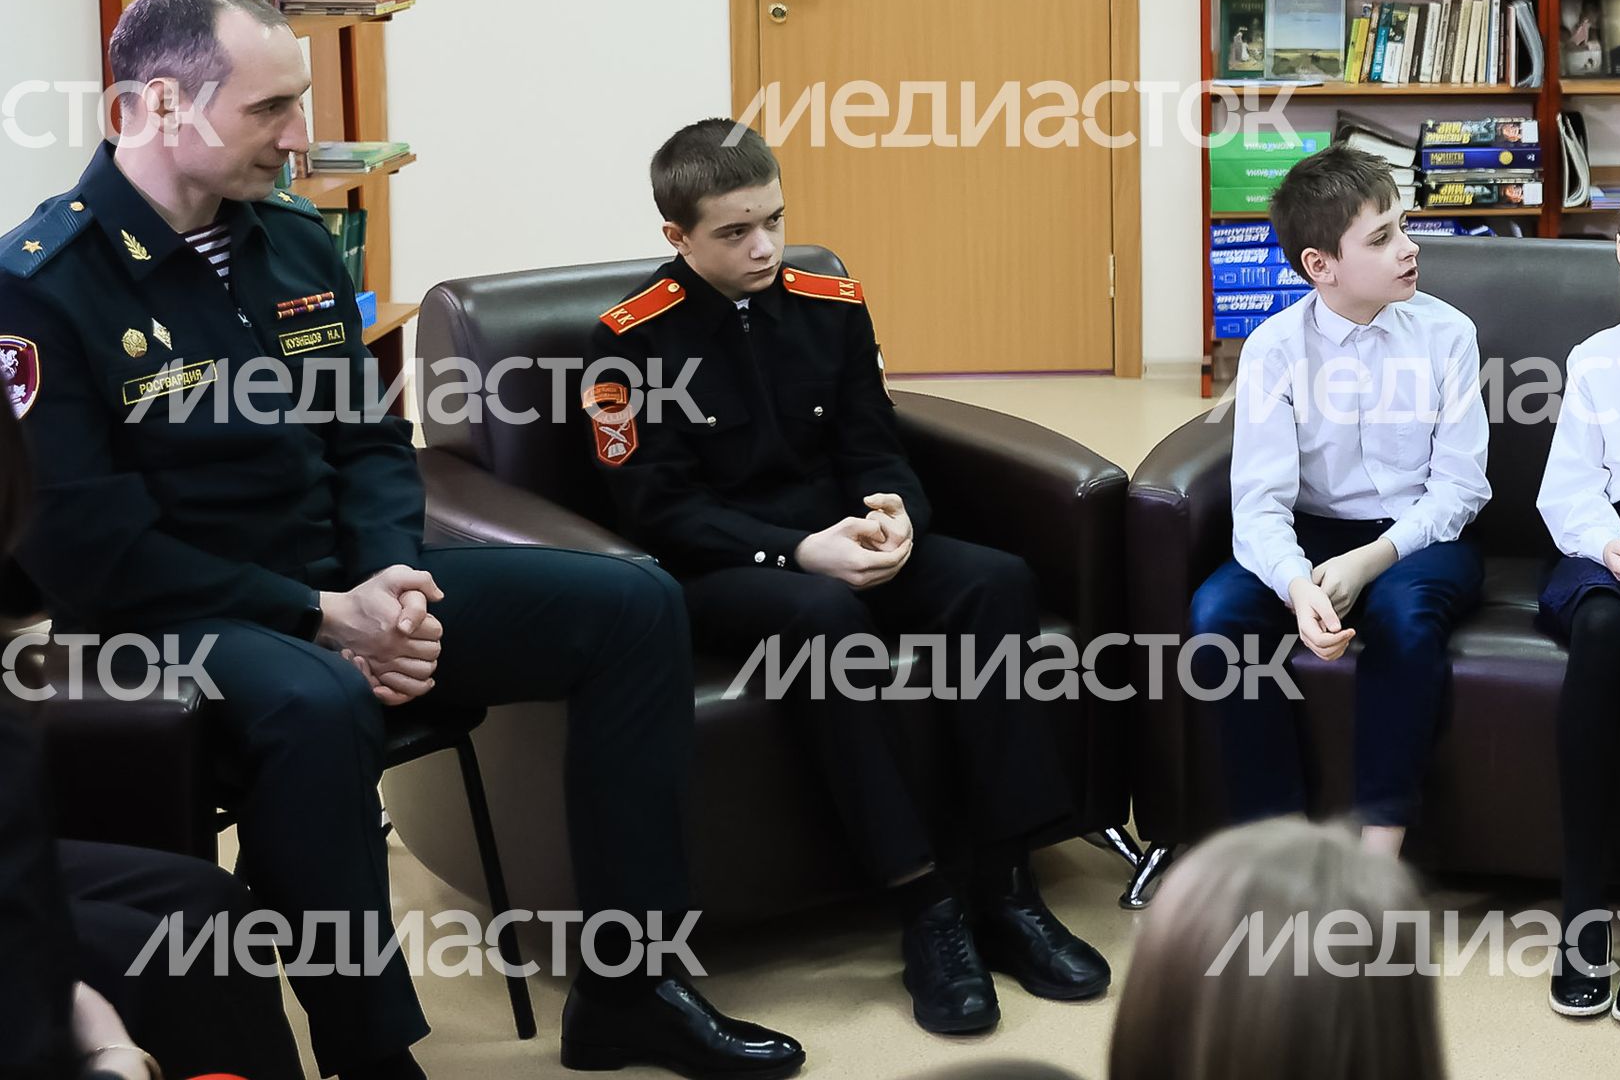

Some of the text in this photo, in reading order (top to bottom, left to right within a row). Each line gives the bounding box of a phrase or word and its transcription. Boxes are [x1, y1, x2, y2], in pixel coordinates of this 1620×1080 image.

[610, 307, 636, 326] КК
[285, 332, 323, 349] КУЗНЕЦОВ
[139, 369, 204, 395] РОСГВАРДИЯ
